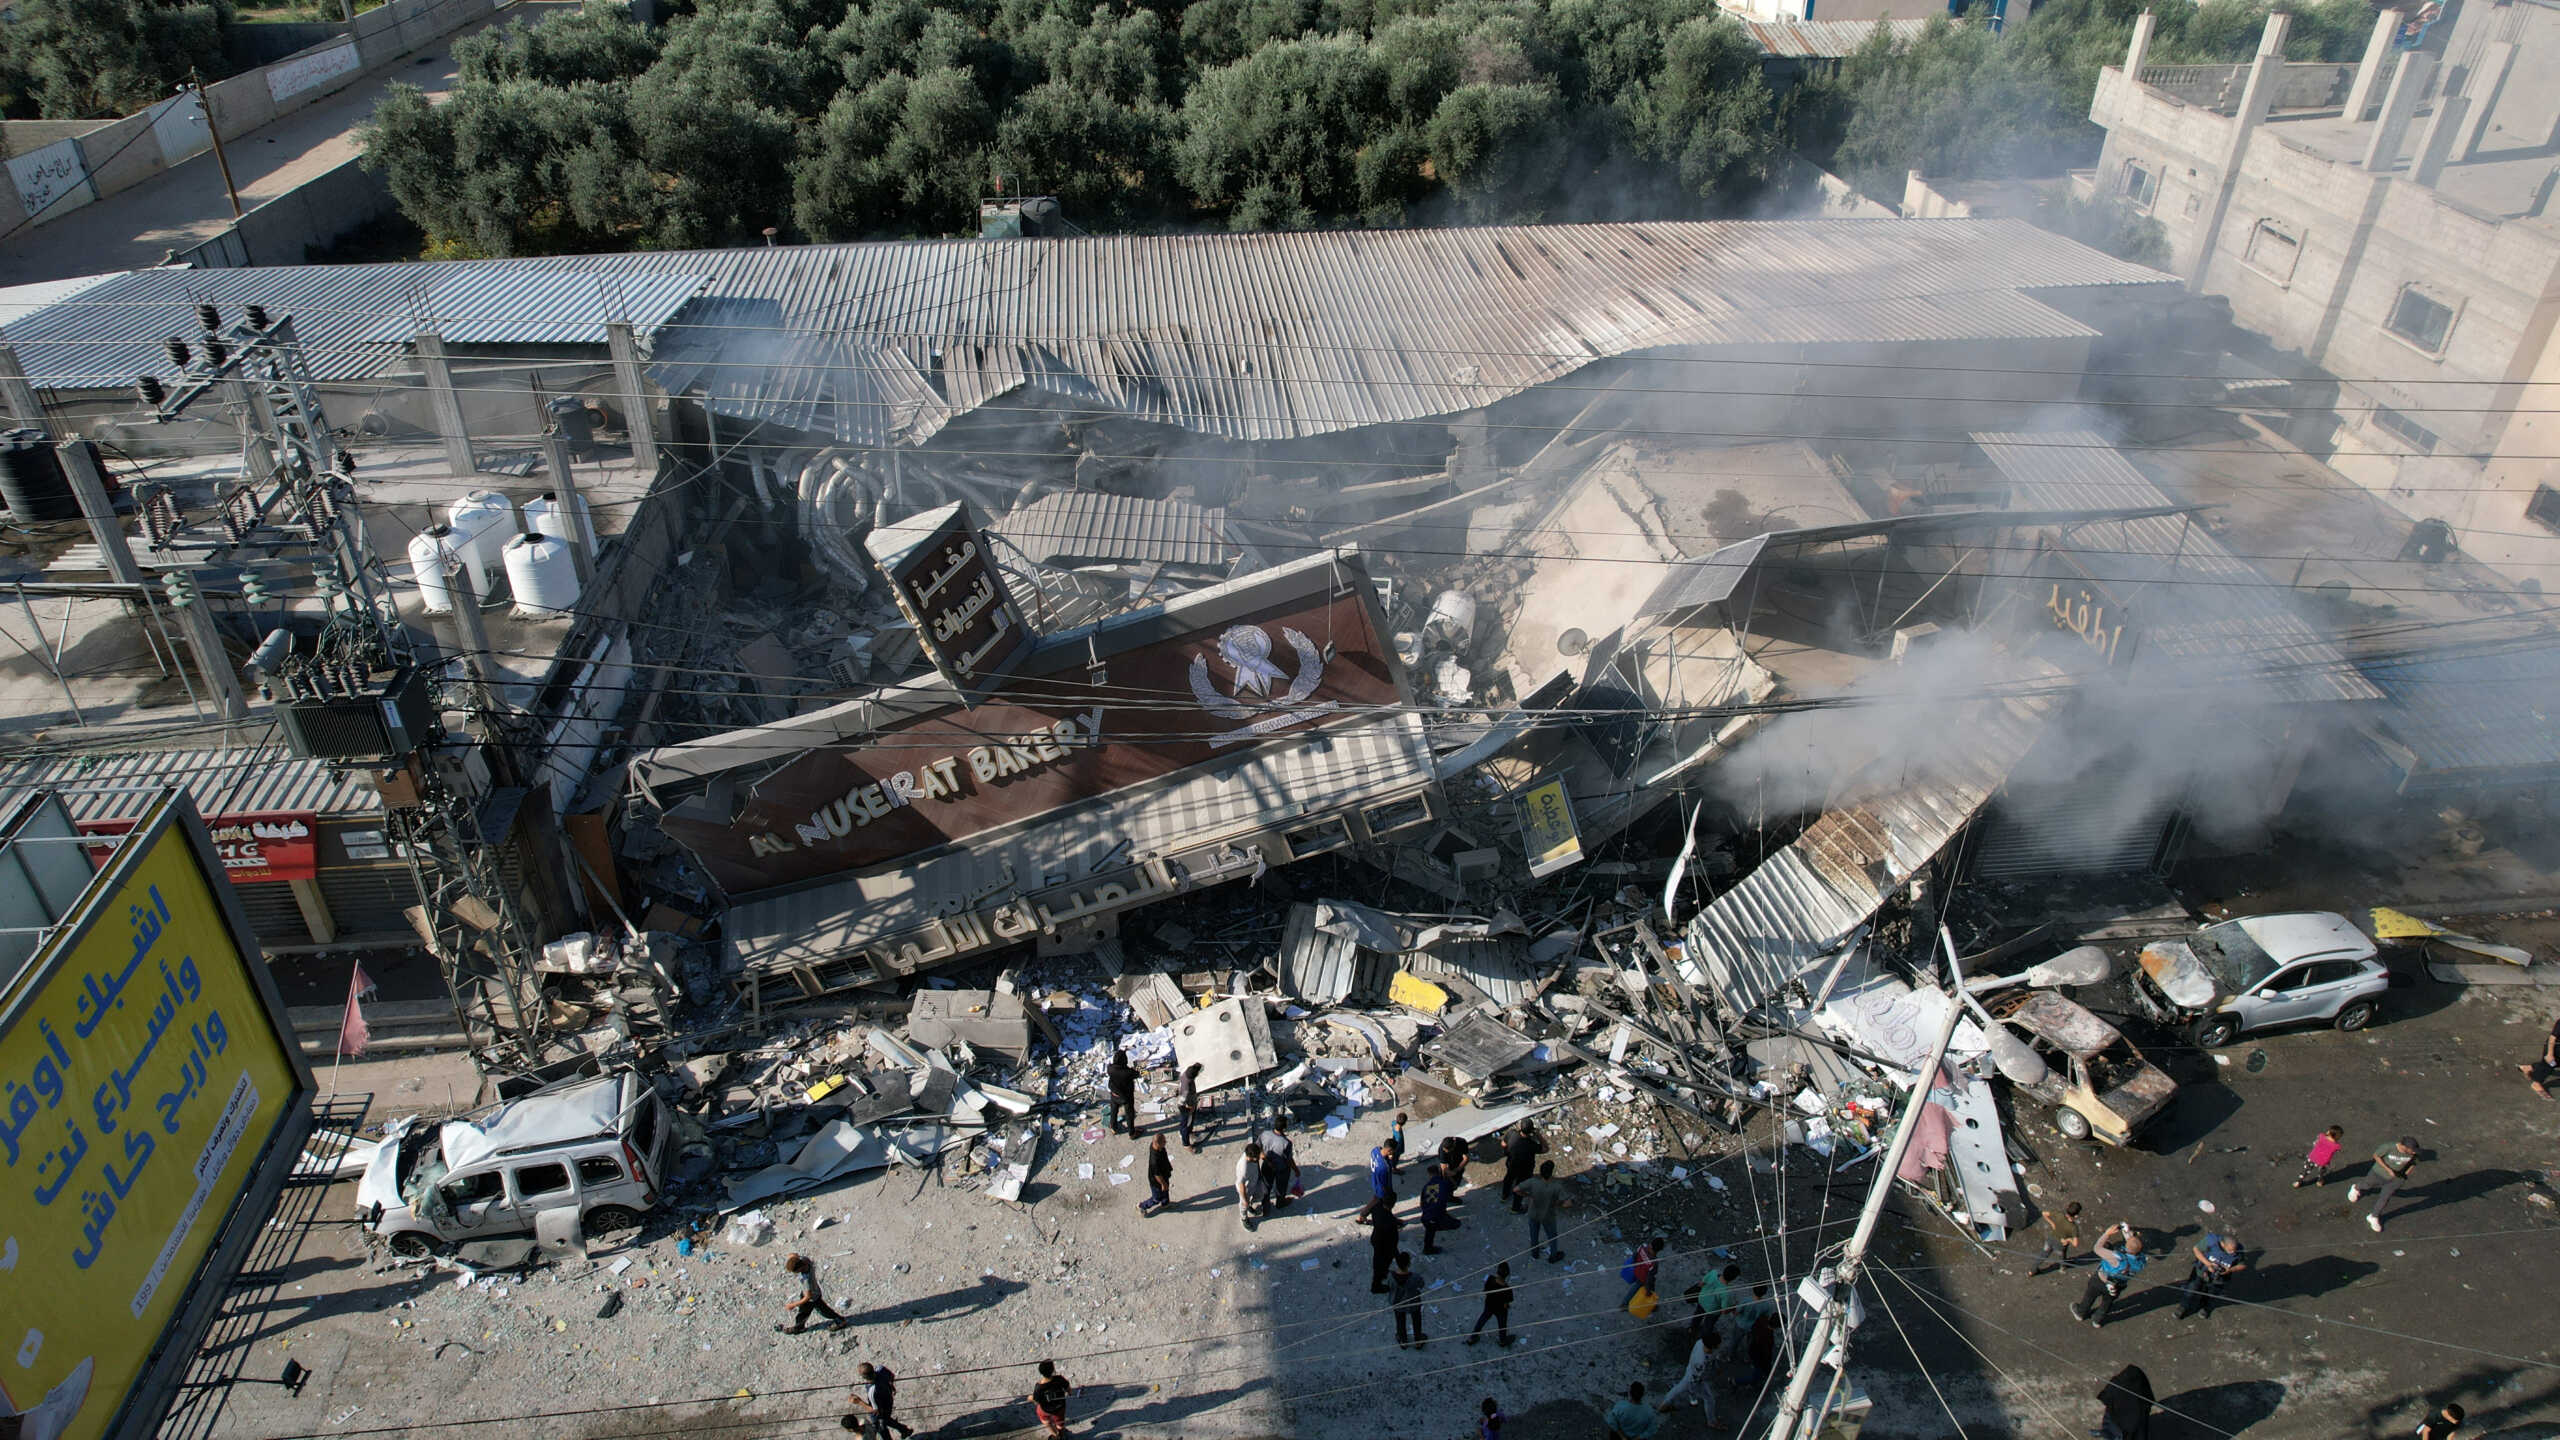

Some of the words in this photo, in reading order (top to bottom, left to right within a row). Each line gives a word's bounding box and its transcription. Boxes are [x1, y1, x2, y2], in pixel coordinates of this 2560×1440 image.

[912, 541, 976, 608] مخبز
[749, 833, 796, 858] AL
[796, 755, 960, 848] NUSEIRAT
[967, 706, 1104, 784] BAKERY
[75, 884, 171, 1039] اشبك
[0, 1017, 72, 1168] أوفر
[93, 955, 201, 1136] وأسرع
[156, 1009, 228, 1135] واربح
[34, 1118, 89, 1207] نت
[72, 1128, 155, 1270] كاش
